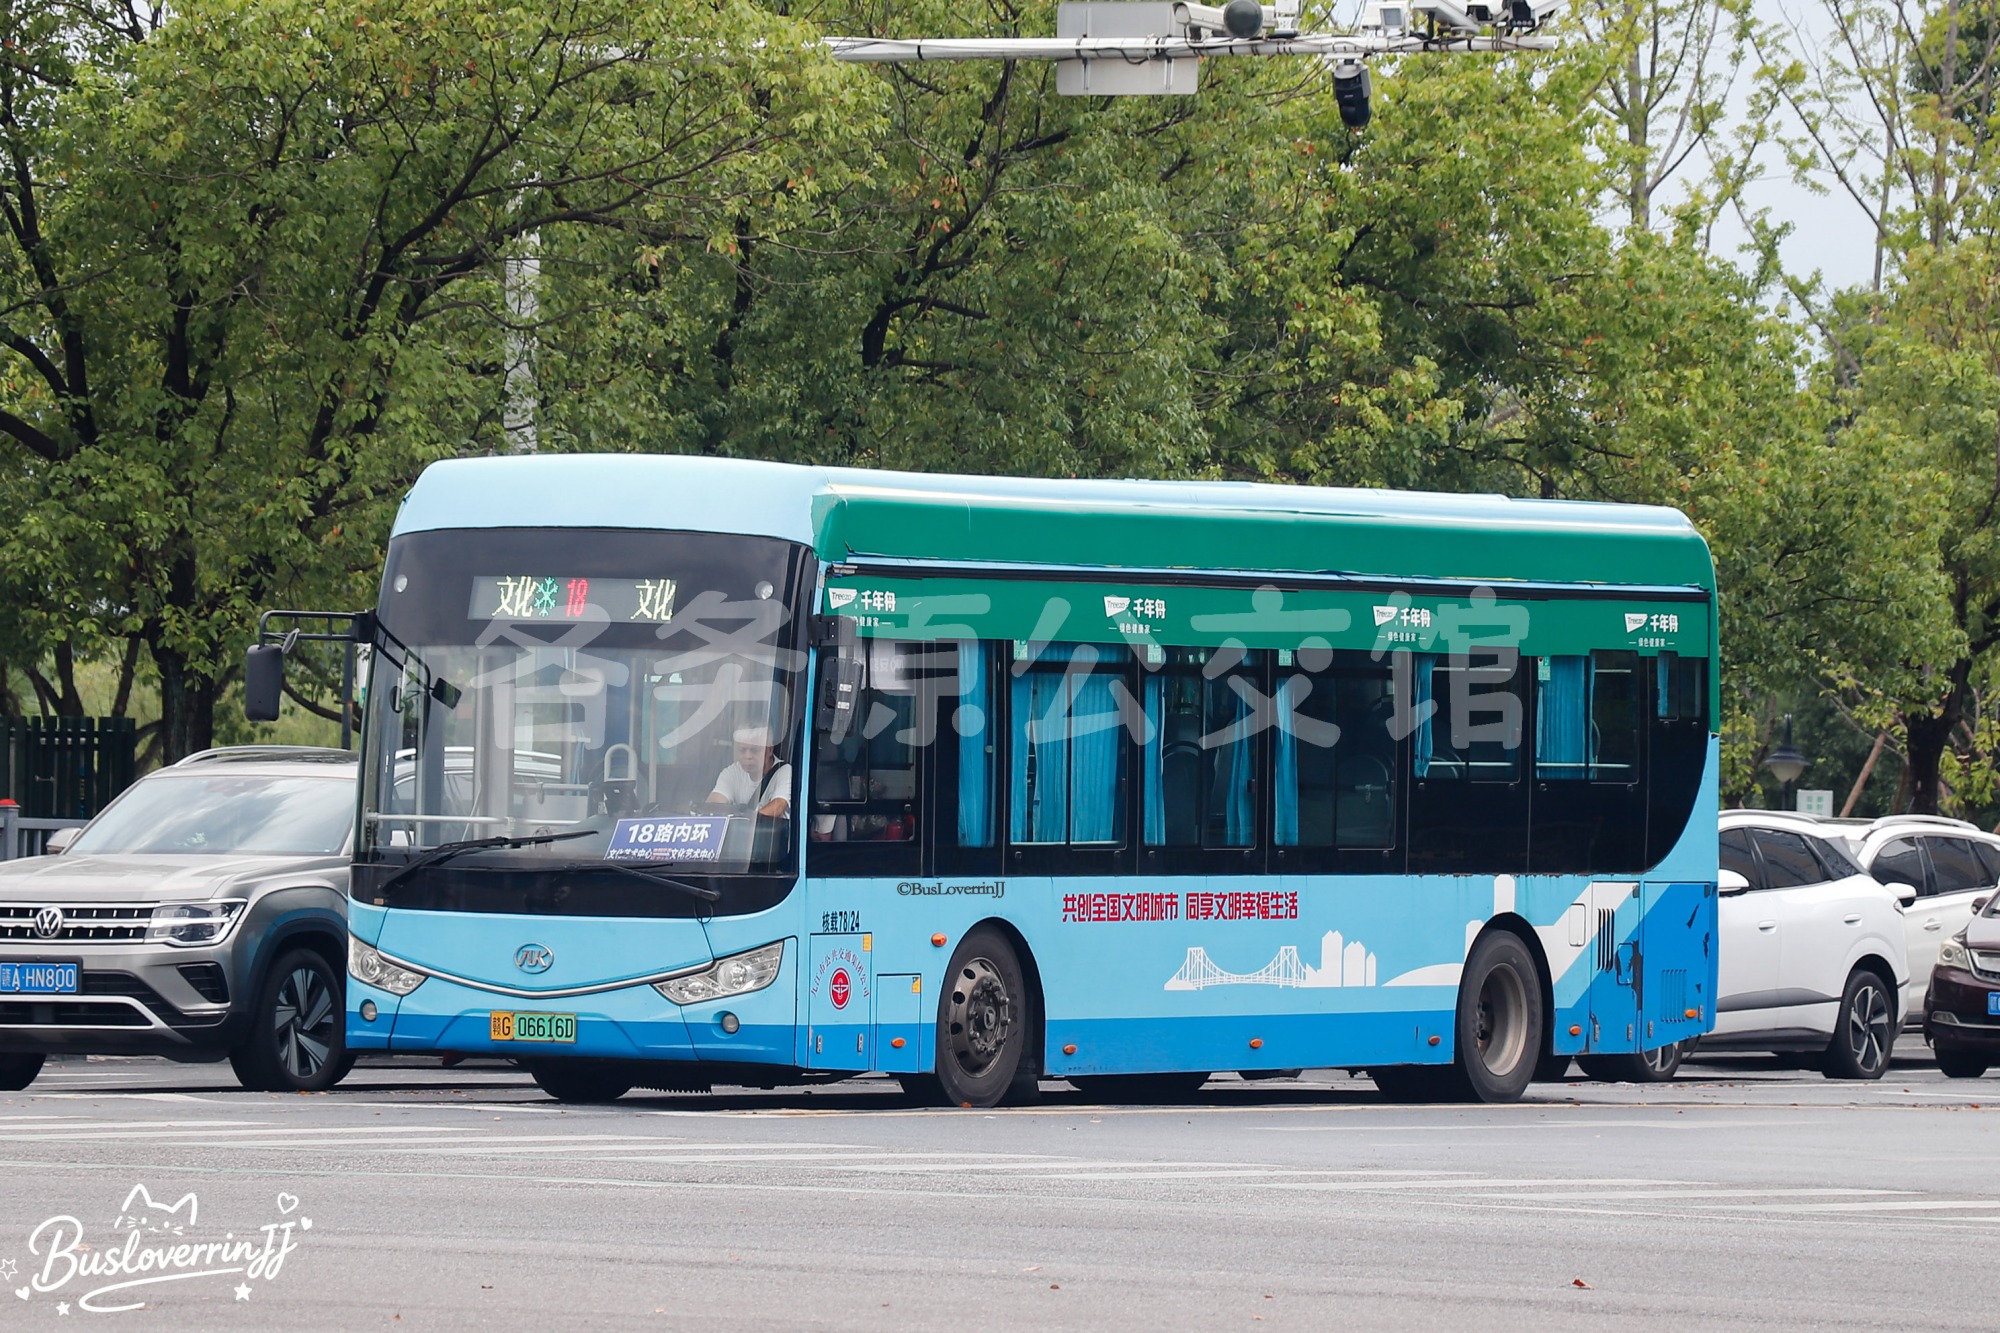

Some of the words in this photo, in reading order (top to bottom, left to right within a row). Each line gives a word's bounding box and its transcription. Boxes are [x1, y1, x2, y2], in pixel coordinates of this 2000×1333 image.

[491, 576, 537, 617] 文化
[566, 578, 589, 617] 18
[630, 578, 677, 621] 文化
[860, 589, 897, 613] 千年舟
[1132, 597, 1167, 620] 千年舟
[1400, 607, 1431, 628] 千年舟
[1649, 613, 1679, 633] 千年舟
[628, 822, 712, 844] 18路内环
[1062, 892, 1179, 923] 共创全国文明城市
[1185, 891, 1299, 921] 同享文明幸福生活
[822, 910, 860, 933] 核载78/24
